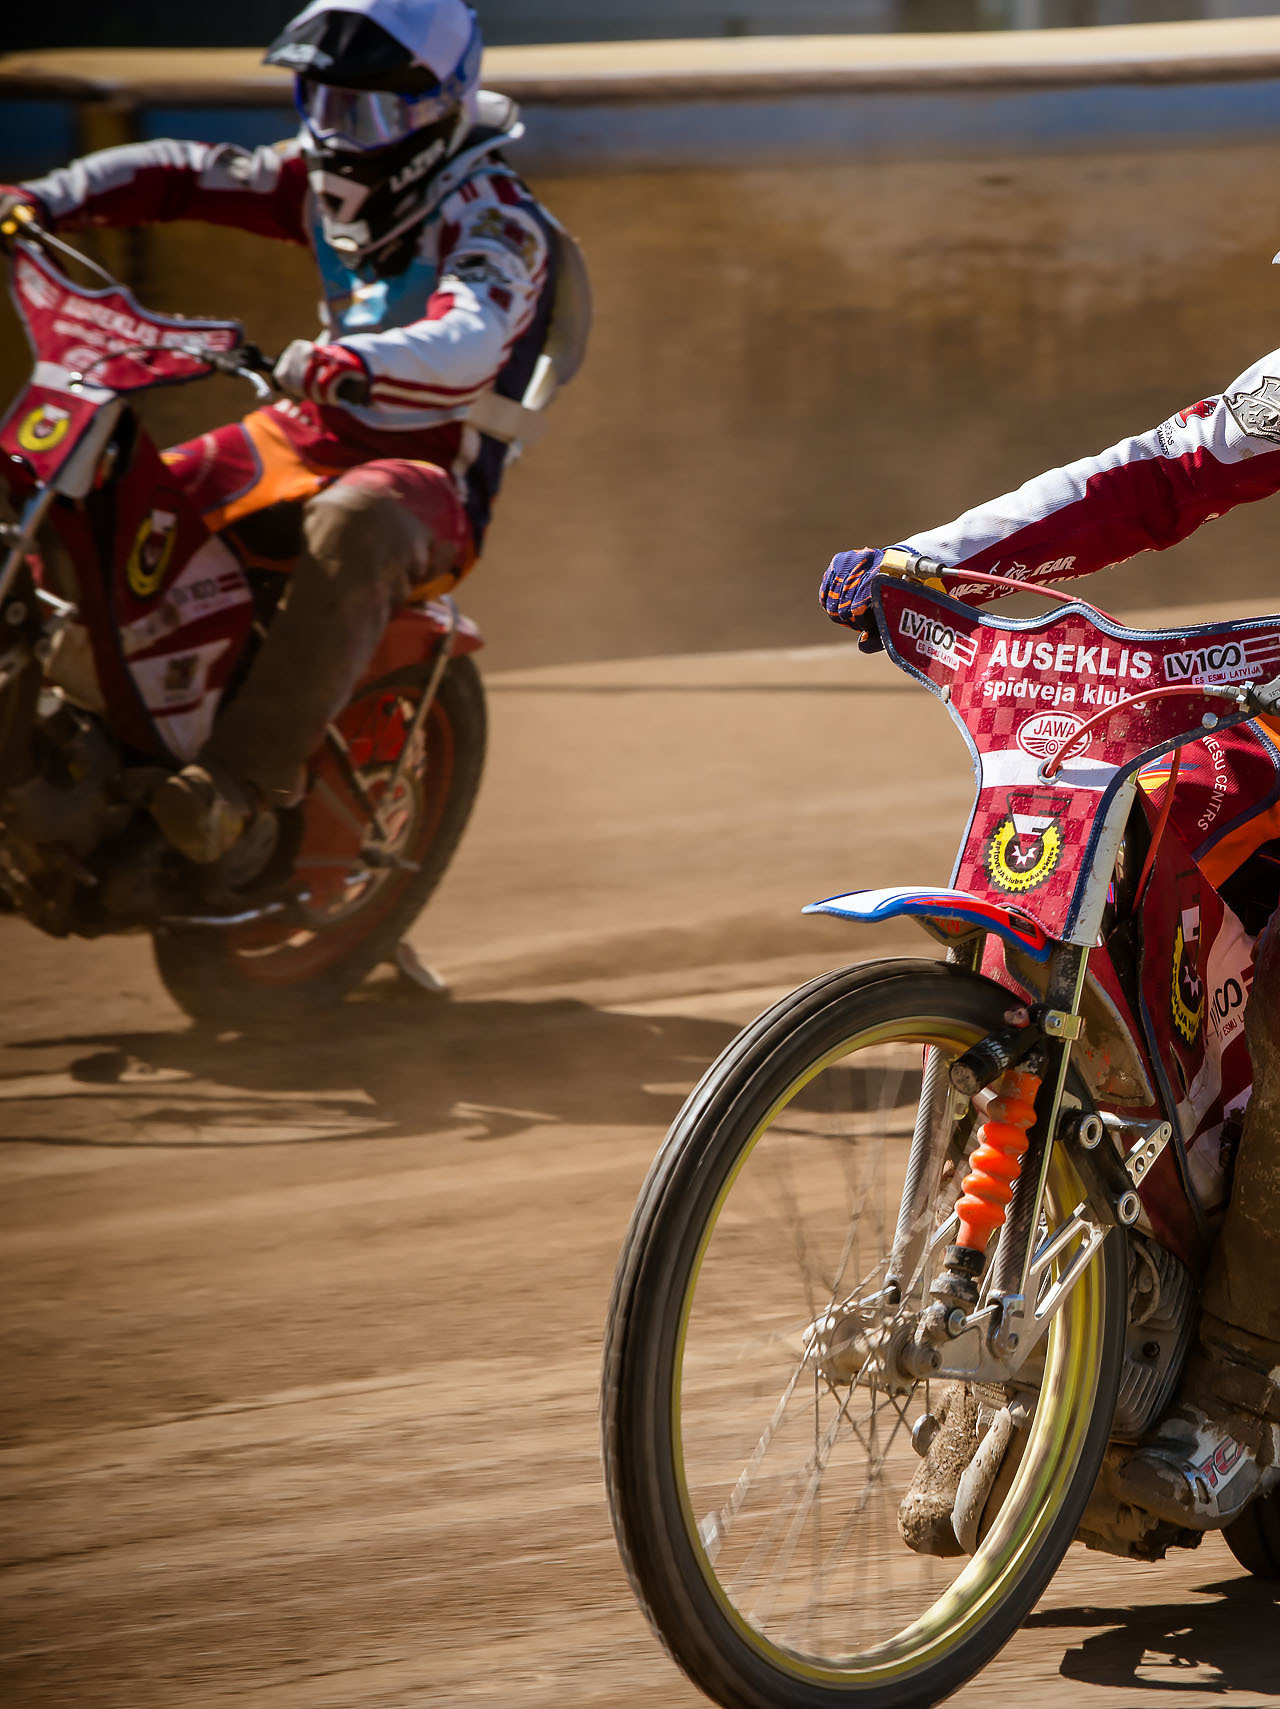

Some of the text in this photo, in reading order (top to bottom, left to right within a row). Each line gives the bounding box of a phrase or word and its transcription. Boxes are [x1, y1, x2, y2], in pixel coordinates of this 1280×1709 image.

[987, 638, 1154, 680] AUSEKLIS
[1194, 665, 1262, 685] ES ESMU LATVIJA
[982, 676, 1077, 707] spīdveja
[1033, 719, 1076, 738] JAWA
[1197, 774, 1228, 831] CENTRS
